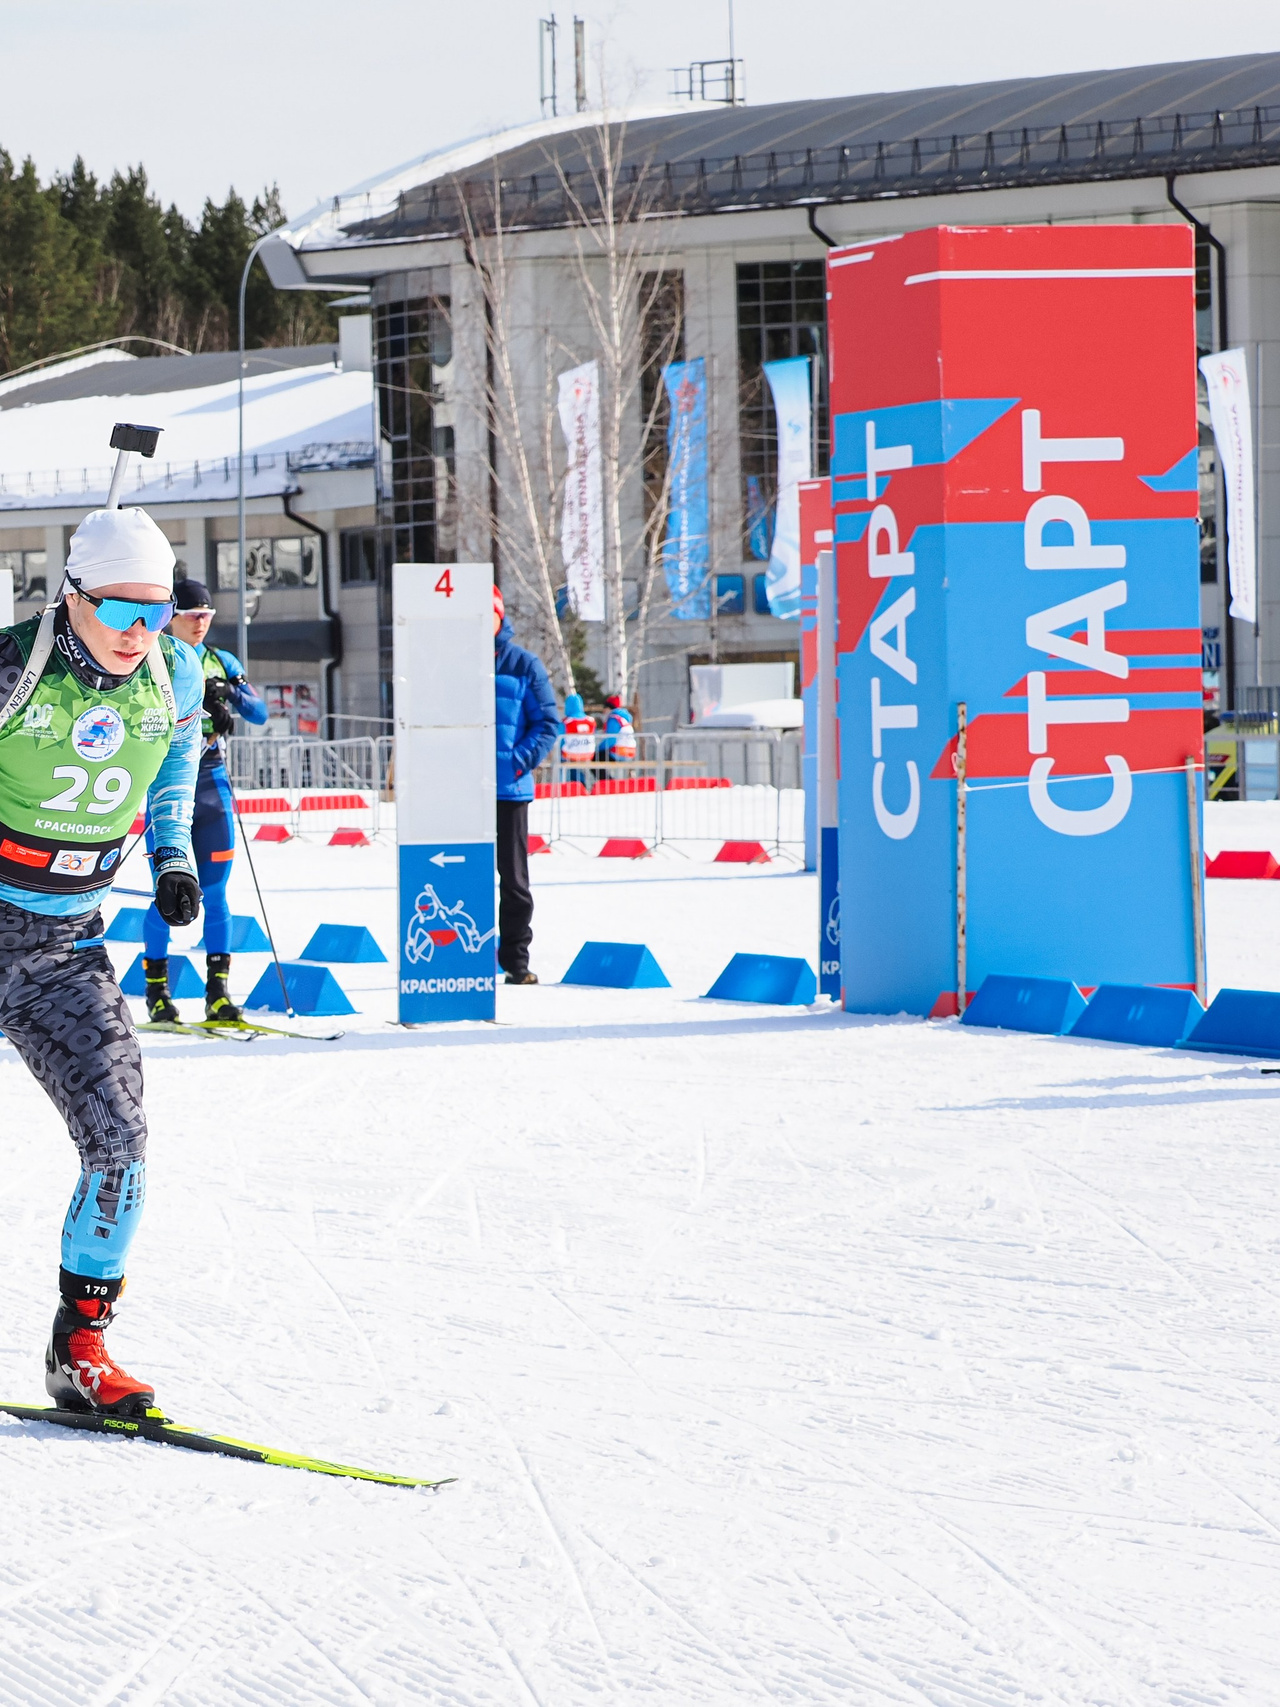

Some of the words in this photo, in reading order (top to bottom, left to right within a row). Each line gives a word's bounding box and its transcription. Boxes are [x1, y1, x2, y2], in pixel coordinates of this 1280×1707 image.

[434, 569, 454, 598] 4
[866, 420, 920, 839] СТАРТ
[1022, 408, 1132, 836] СТАРТ
[8, 670, 36, 710] LARSEN
[39, 765, 133, 815] 29
[34, 818, 115, 836] КРАСНОЯРСК
[400, 977, 494, 994] КРАСНОЯРСК
[84, 1284, 109, 1296] 179
[103, 1419, 139, 1432] FISCHER
